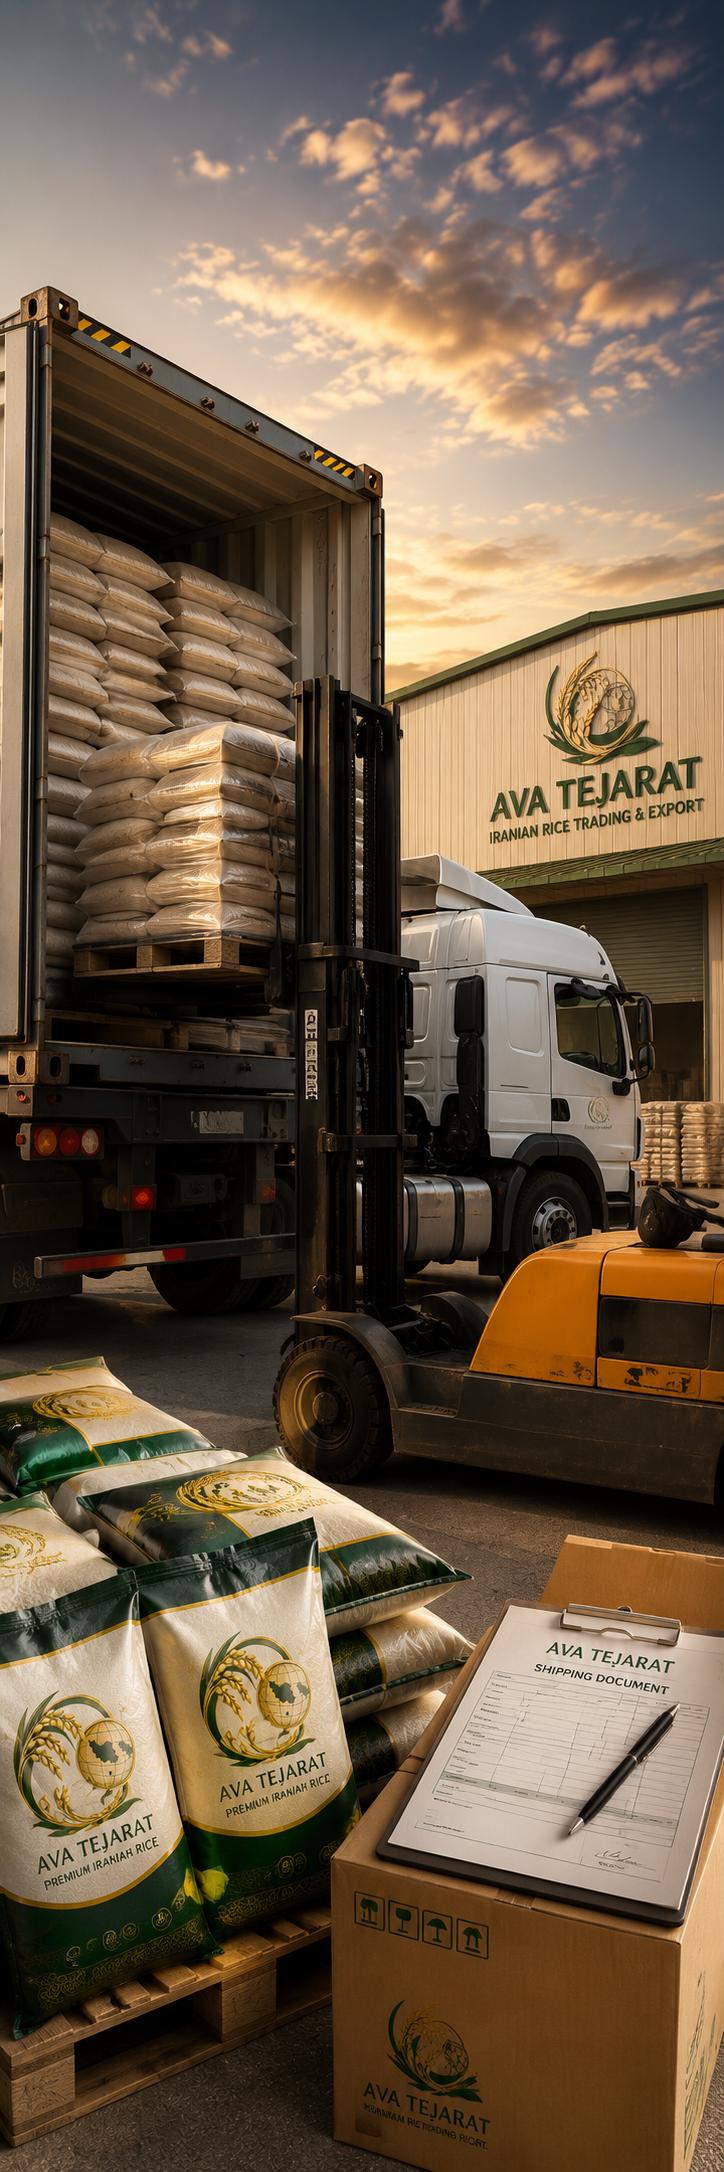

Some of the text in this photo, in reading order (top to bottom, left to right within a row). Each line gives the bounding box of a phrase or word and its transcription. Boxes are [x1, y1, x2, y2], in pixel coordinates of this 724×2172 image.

[490, 756, 703, 823] AVA TEJARAT
[489, 798, 705, 844] IRANIAN RICE TRADING & EXPORT
[534, 1663, 670, 1695] SHIPPING DOCUMENT
[546, 1641, 675, 1674] AVA TEJARAT
[220, 1752, 326, 1803] AVA TEJARAT
[225, 1796, 270, 1818] PREMIUM
[38, 1814, 153, 1875] AVA TEJARAT
[43, 1864, 91, 1891] PREMIUM
[135, 1836, 160, 1855] RICE
[363, 2081, 401, 2107] AVA
[406, 2094, 491, 2135] TEJARAT
